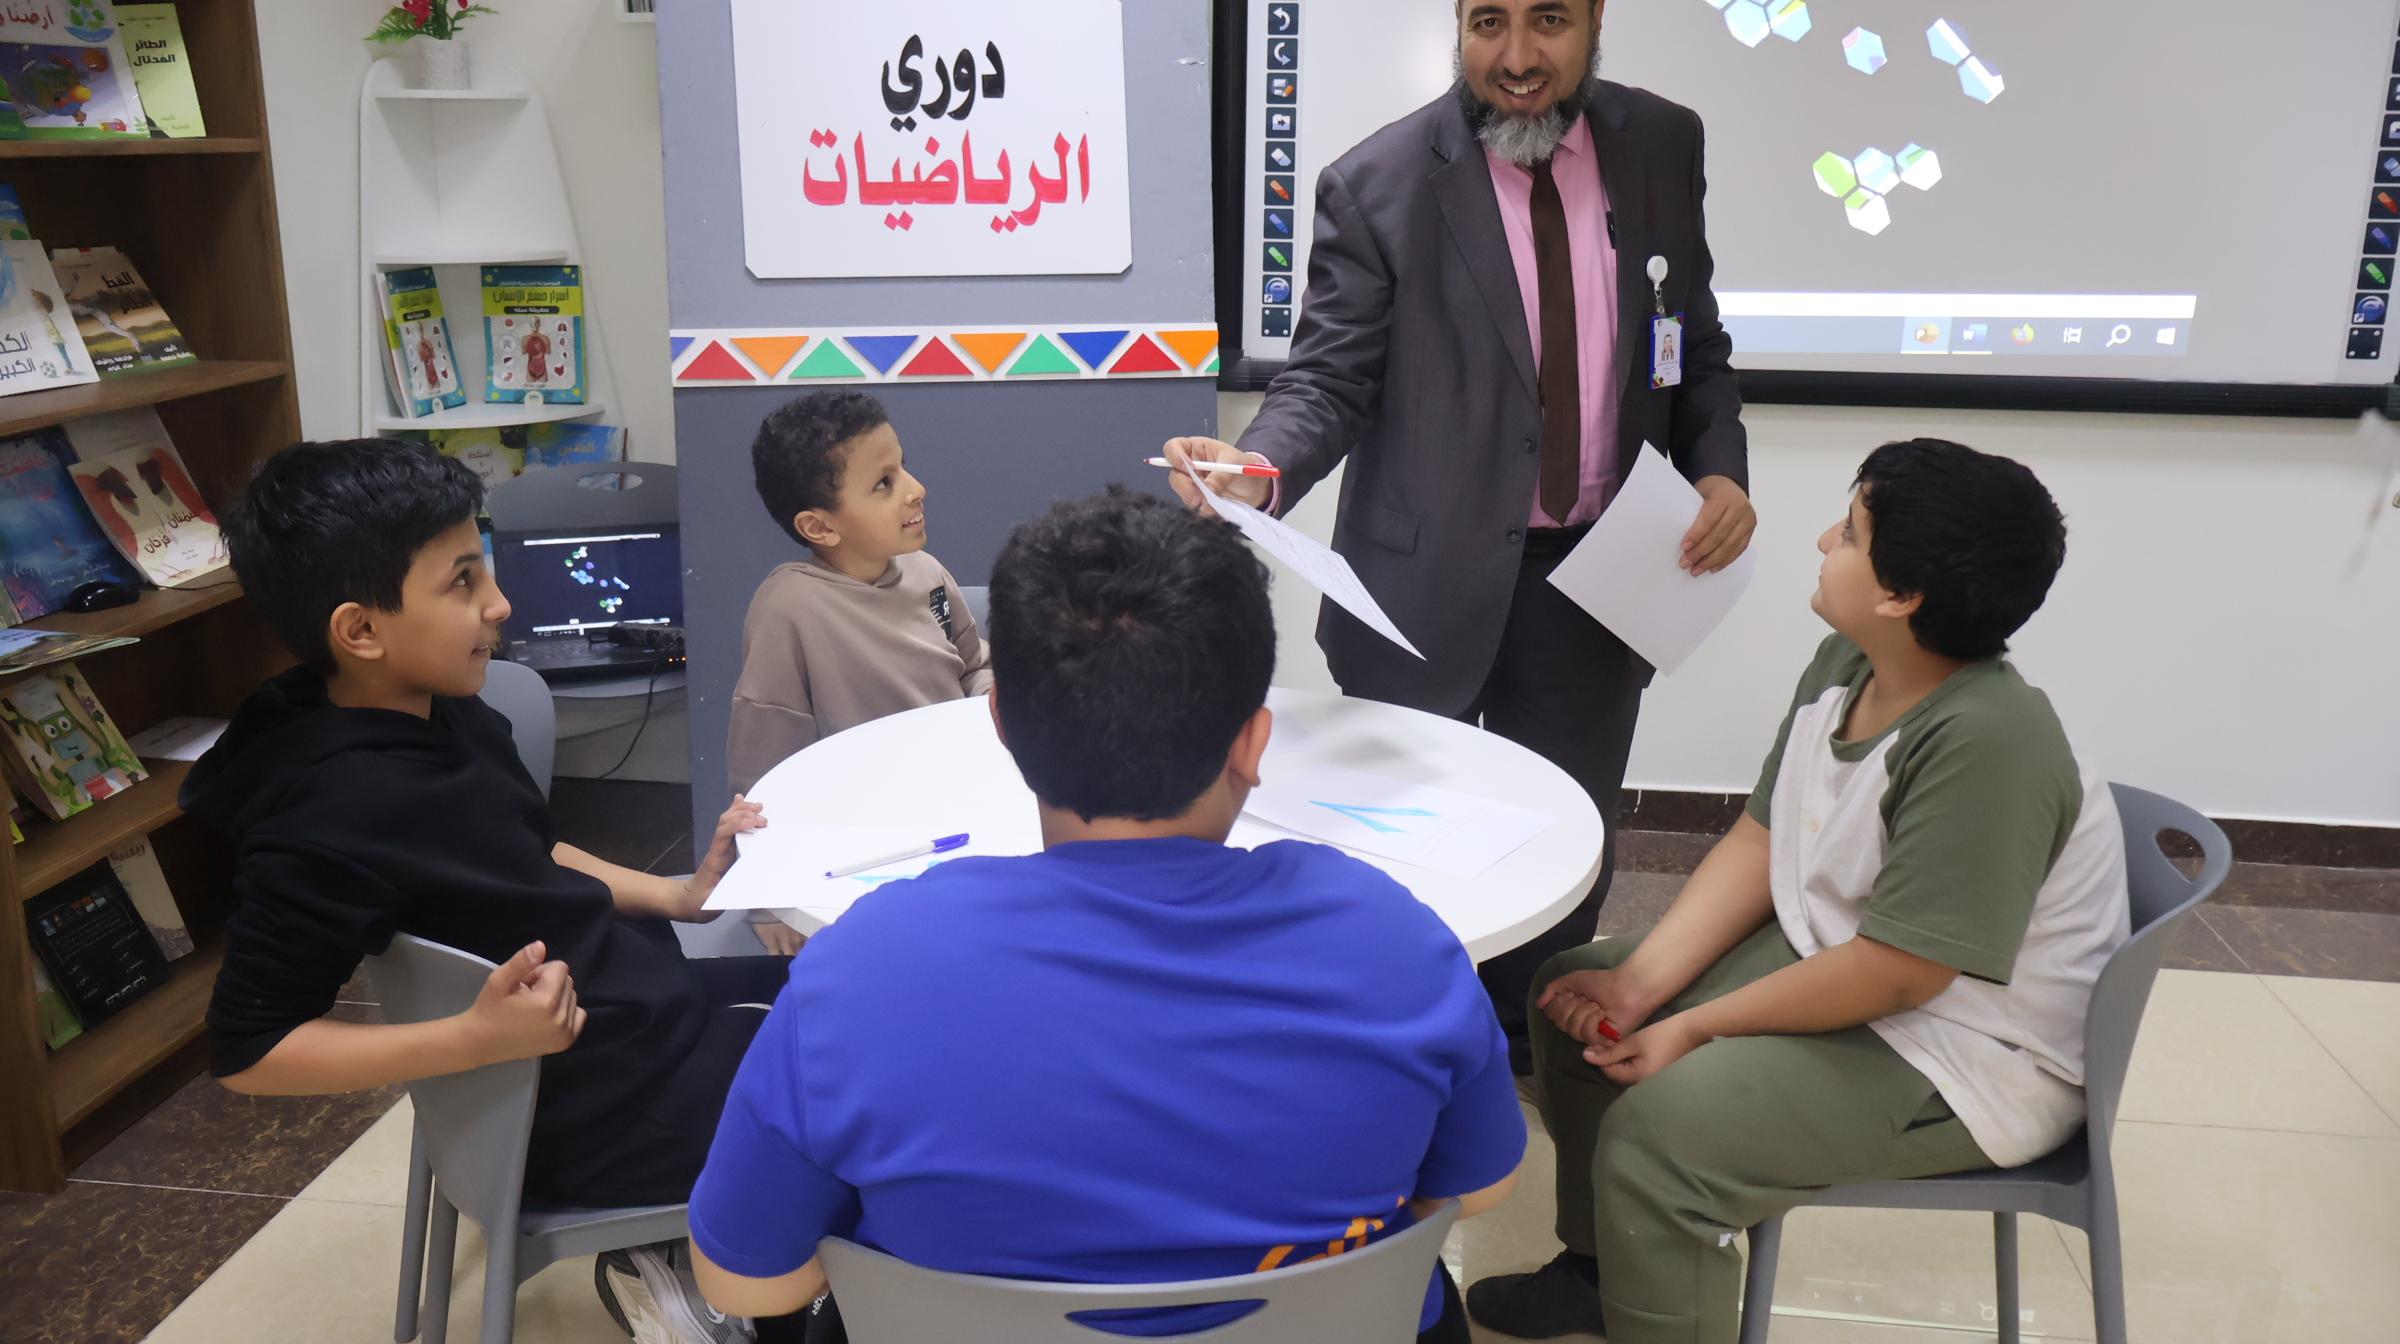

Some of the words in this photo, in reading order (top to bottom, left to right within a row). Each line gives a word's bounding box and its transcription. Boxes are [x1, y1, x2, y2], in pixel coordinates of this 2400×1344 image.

[135, 40, 168, 51] الطائر
[881, 34, 1006, 132] دوري
[803, 128, 1090, 233] الرياضيات
[101, 271, 135, 289] القط
